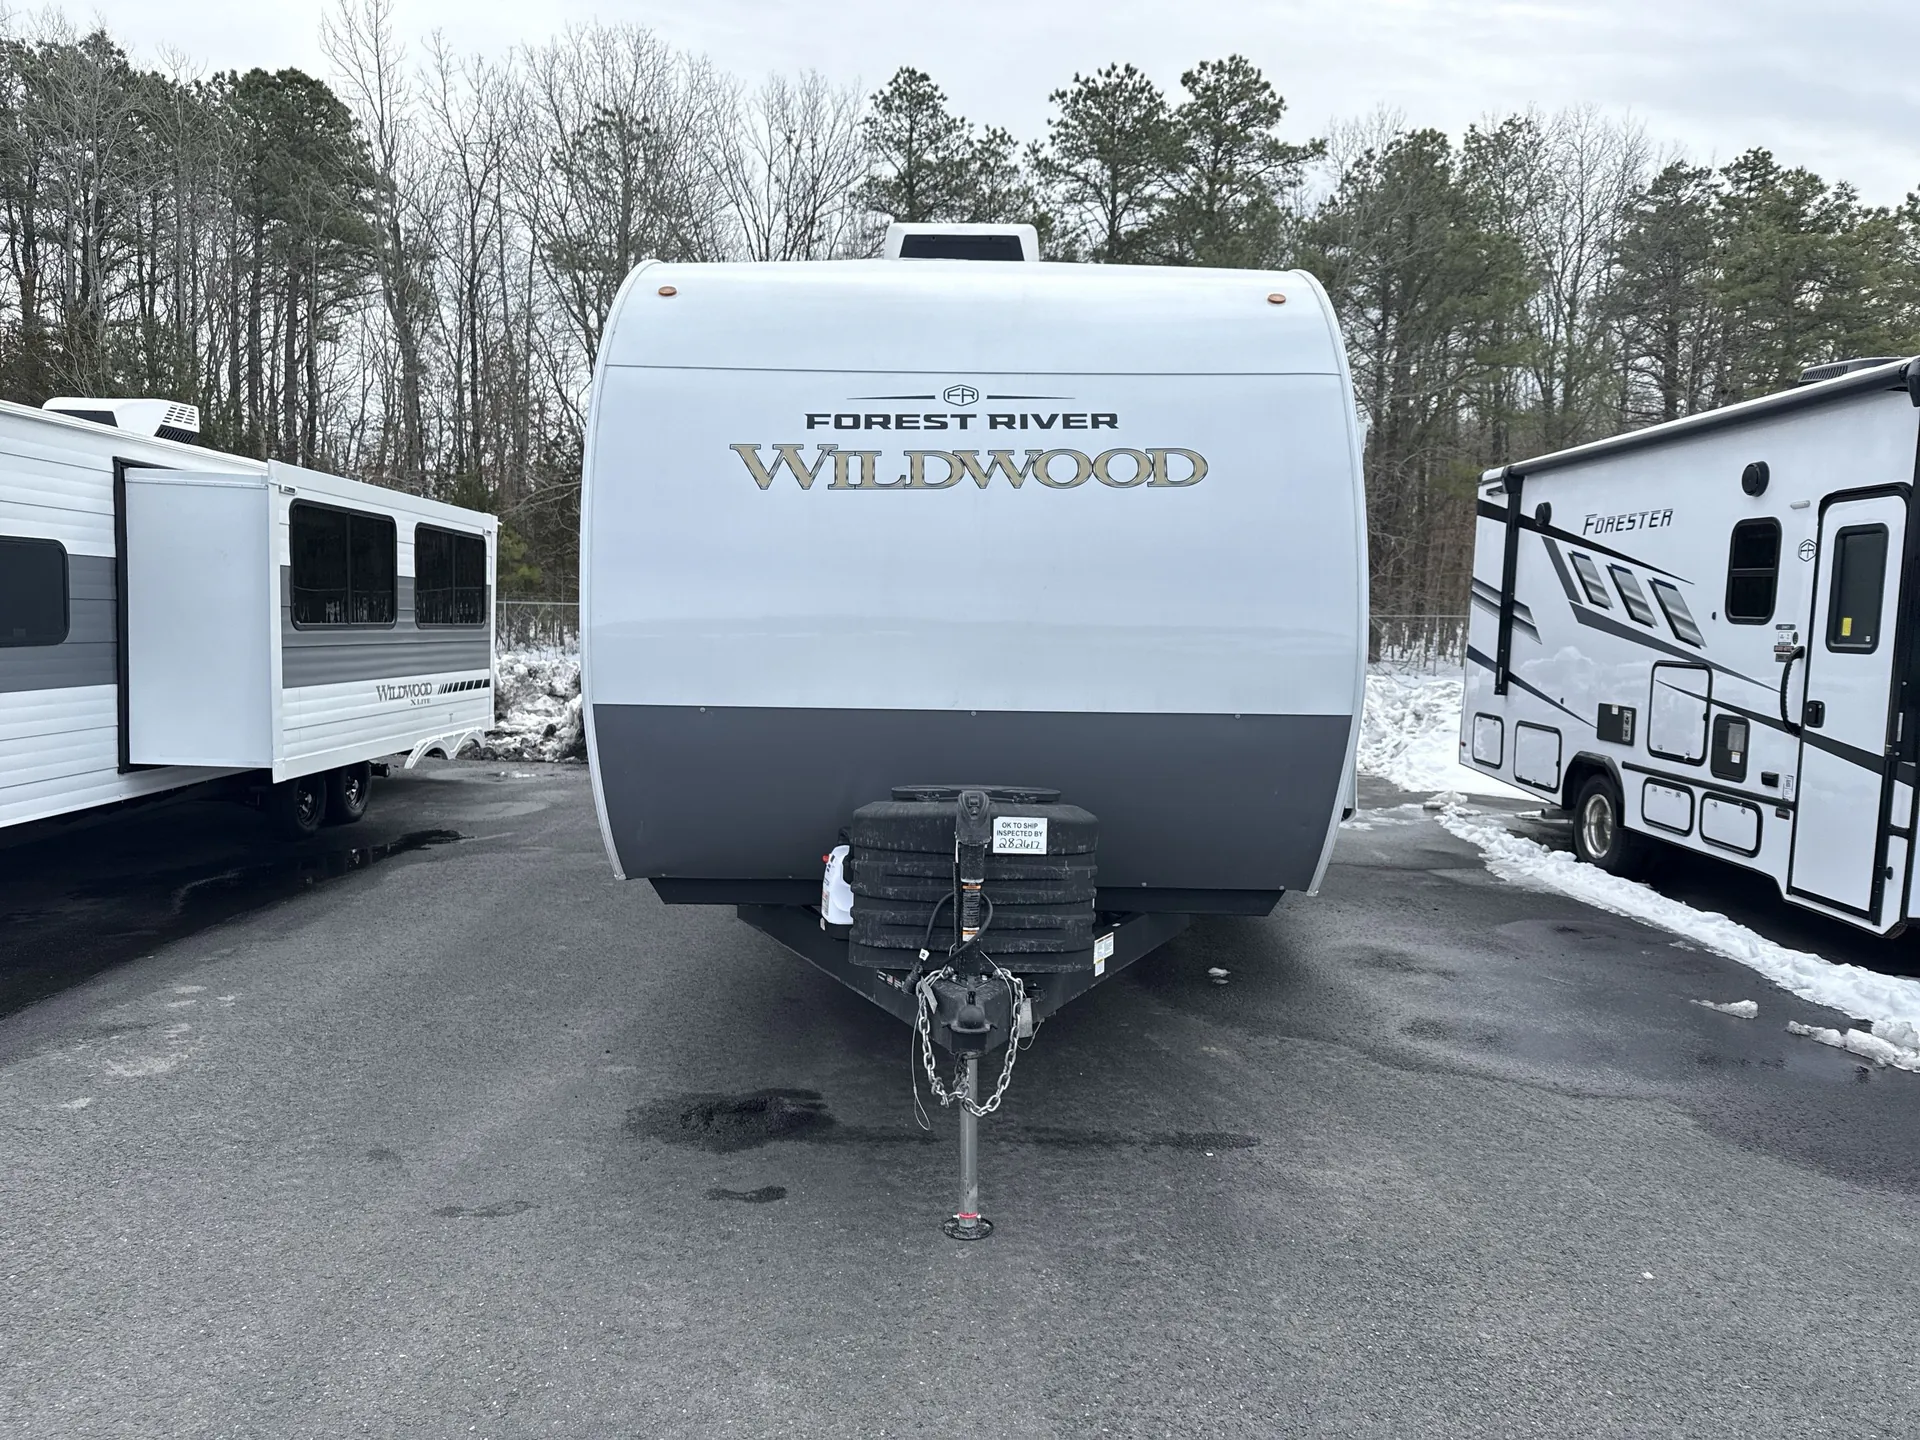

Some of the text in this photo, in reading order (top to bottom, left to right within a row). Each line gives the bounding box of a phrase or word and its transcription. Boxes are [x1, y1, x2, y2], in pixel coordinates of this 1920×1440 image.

[804, 413, 1119, 431] FOREST RIVER
[729, 443, 1209, 490] WILDWOOD
[1582, 508, 1673, 536] FORESTER
[376, 682, 432, 702] WILDWOOD
